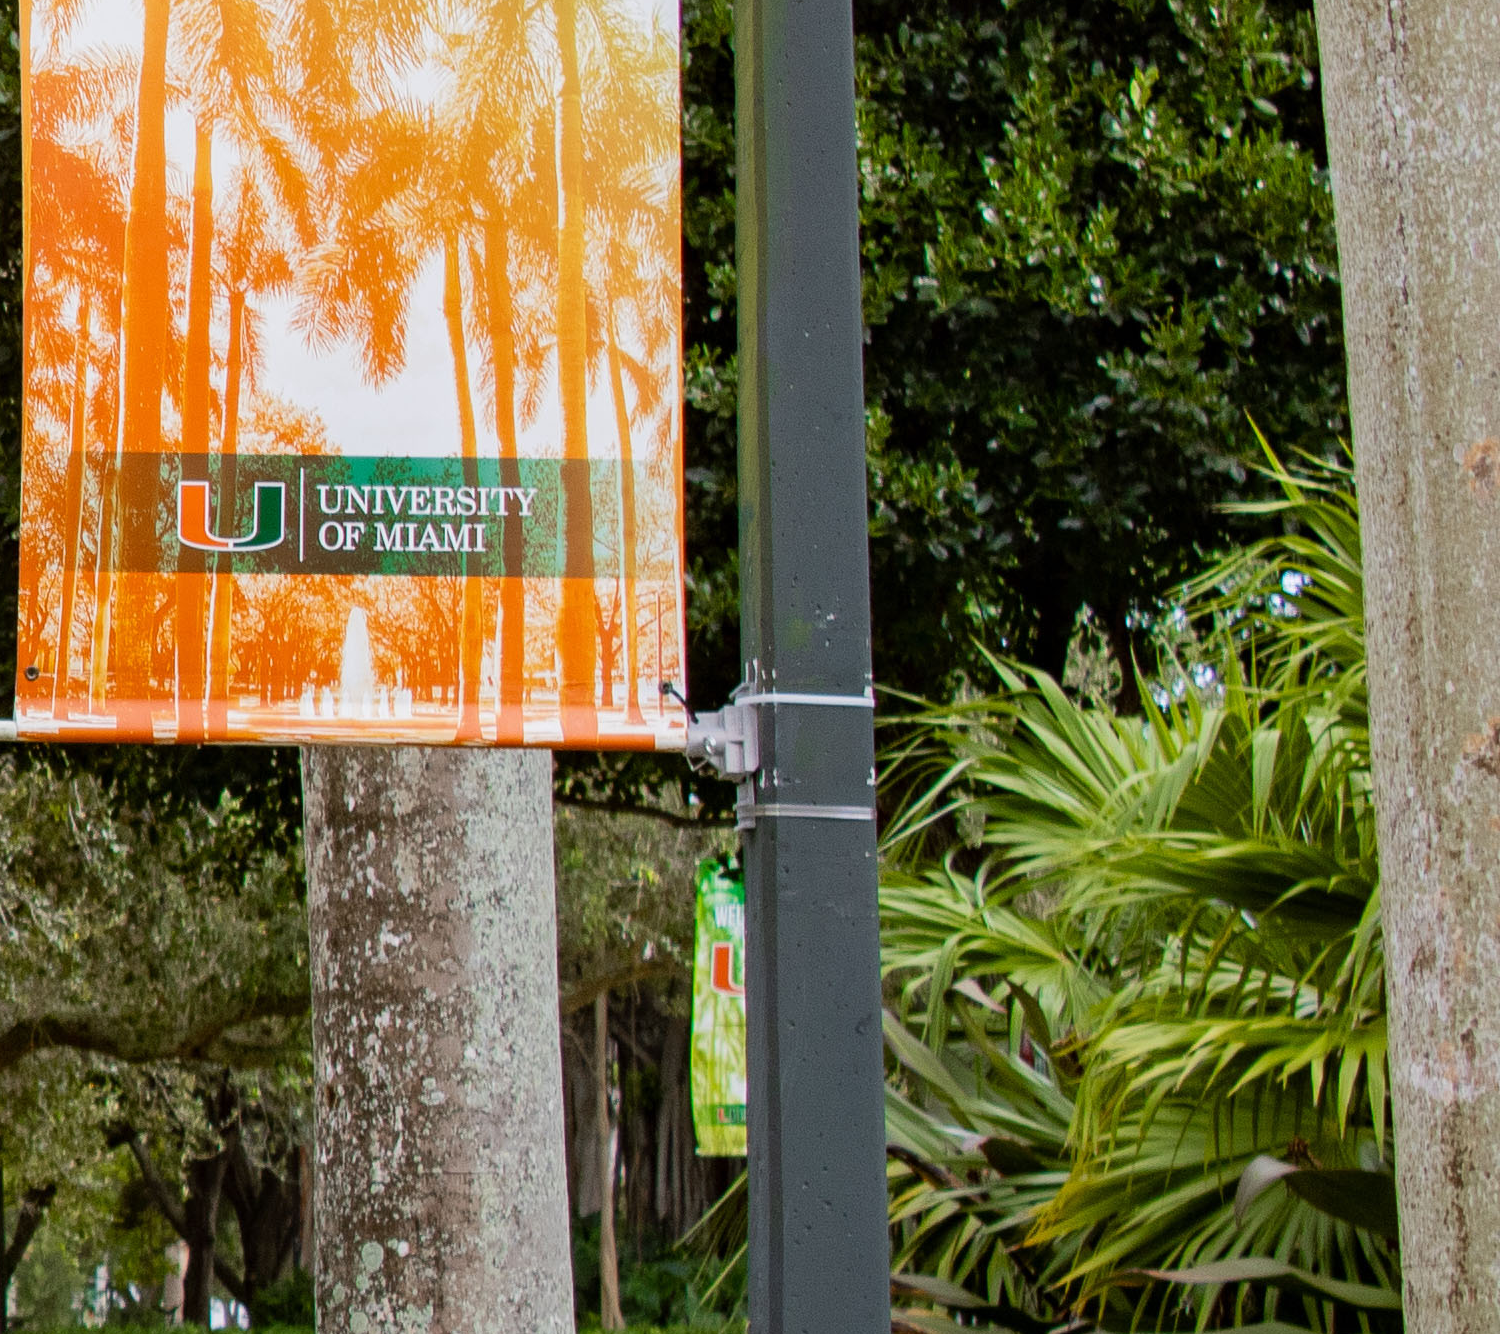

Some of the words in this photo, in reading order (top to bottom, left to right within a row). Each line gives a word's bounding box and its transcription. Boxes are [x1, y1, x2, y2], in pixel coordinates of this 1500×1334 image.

[177, 481, 286, 552] U
[318, 485, 537, 517] UNIVERSITY
[319, 523, 365, 551] OF
[374, 523, 487, 553] MIAMI
